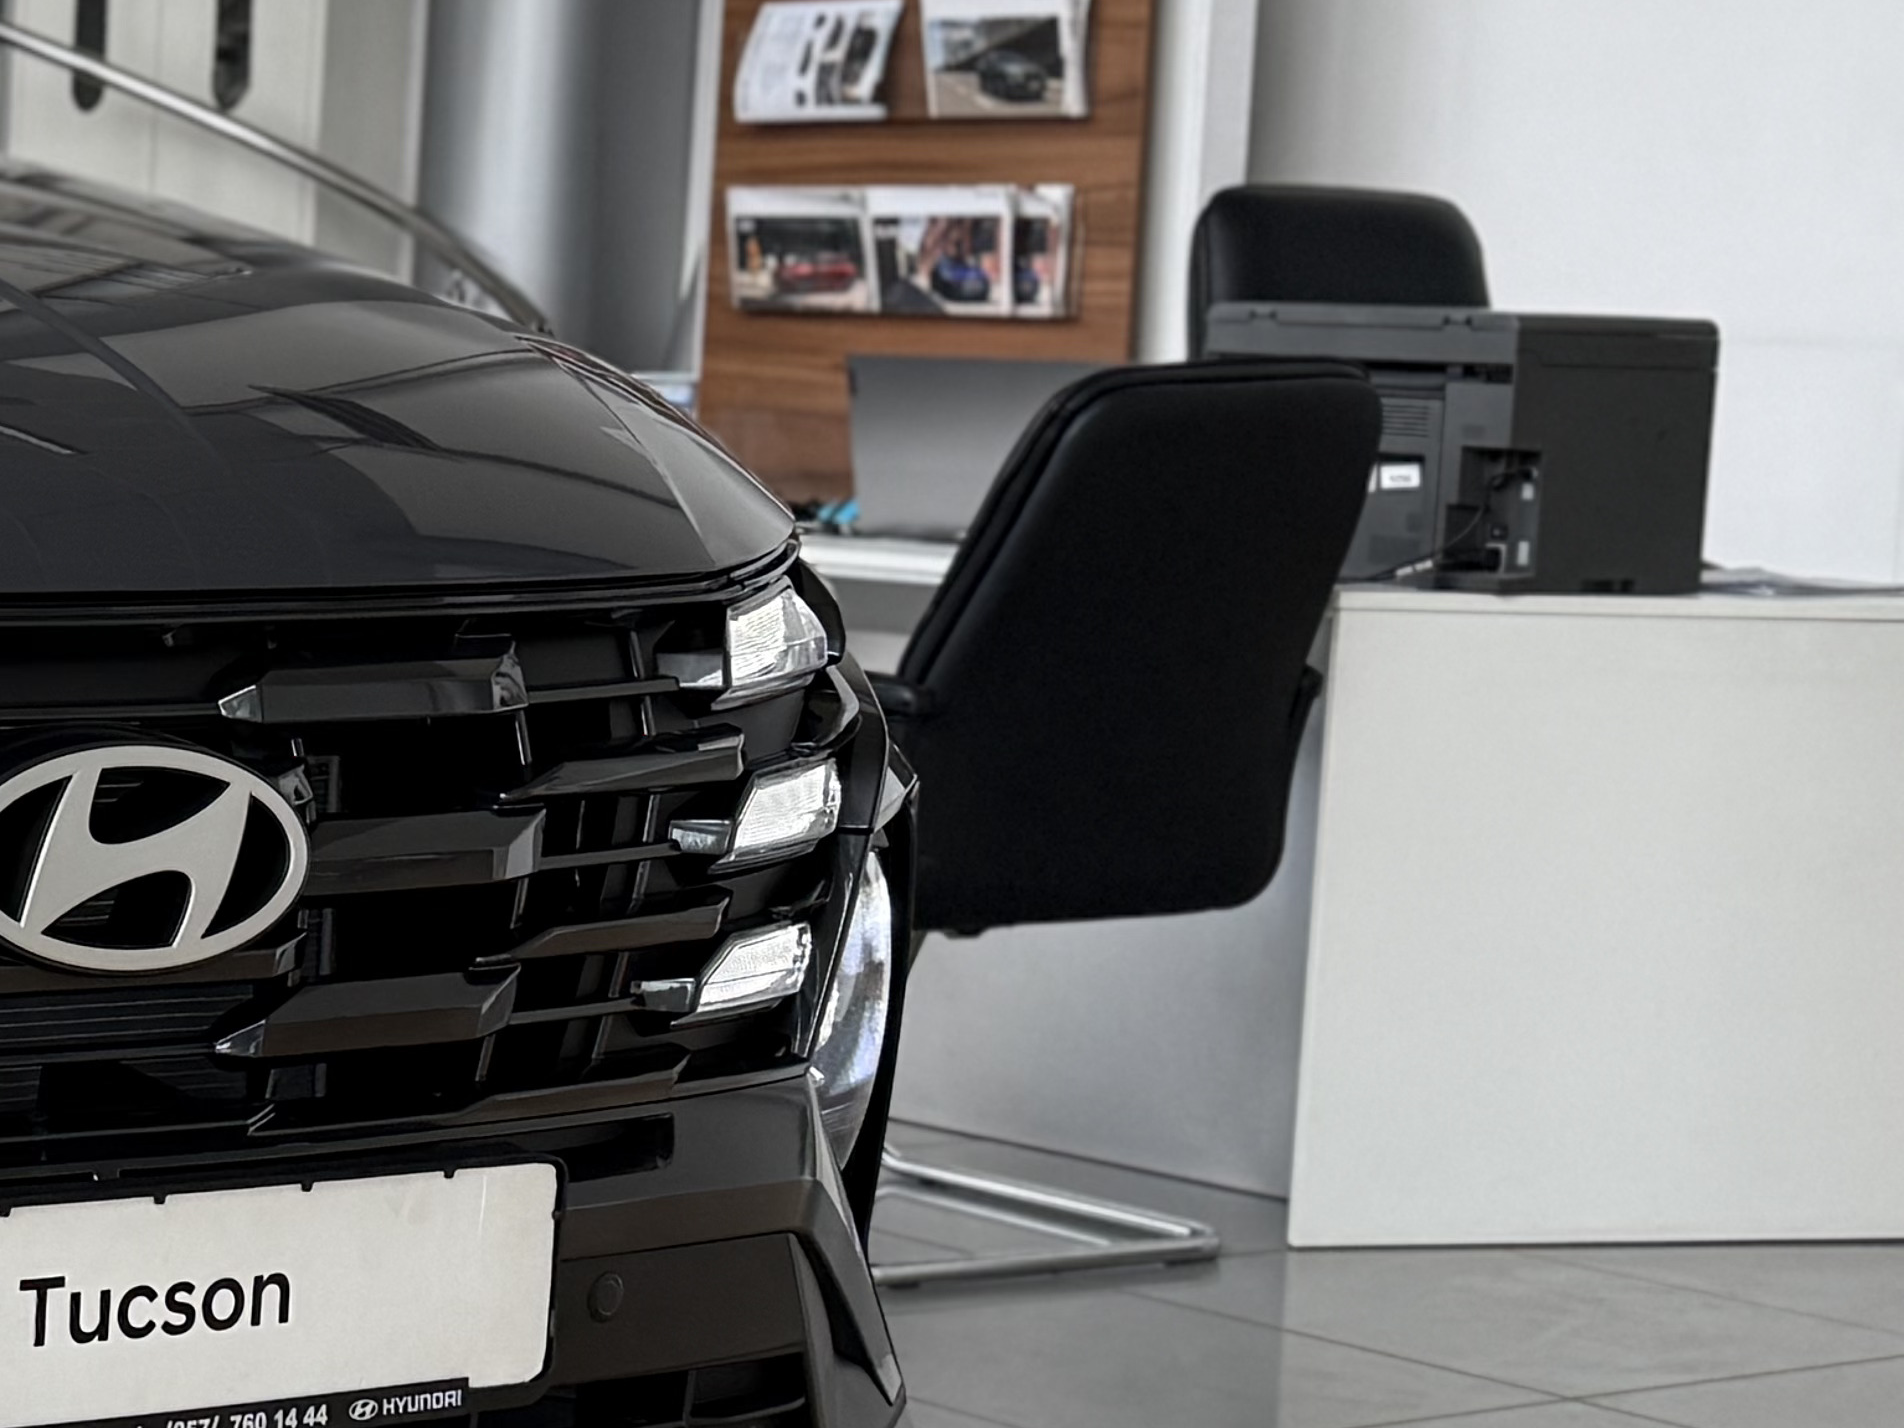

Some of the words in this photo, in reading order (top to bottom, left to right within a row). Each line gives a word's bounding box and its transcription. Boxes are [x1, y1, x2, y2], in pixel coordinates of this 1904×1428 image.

[19, 1272, 291, 1347] Tucson
[303, 1404, 329, 1428] 44
[382, 1389, 463, 1416] HYUNDAI
